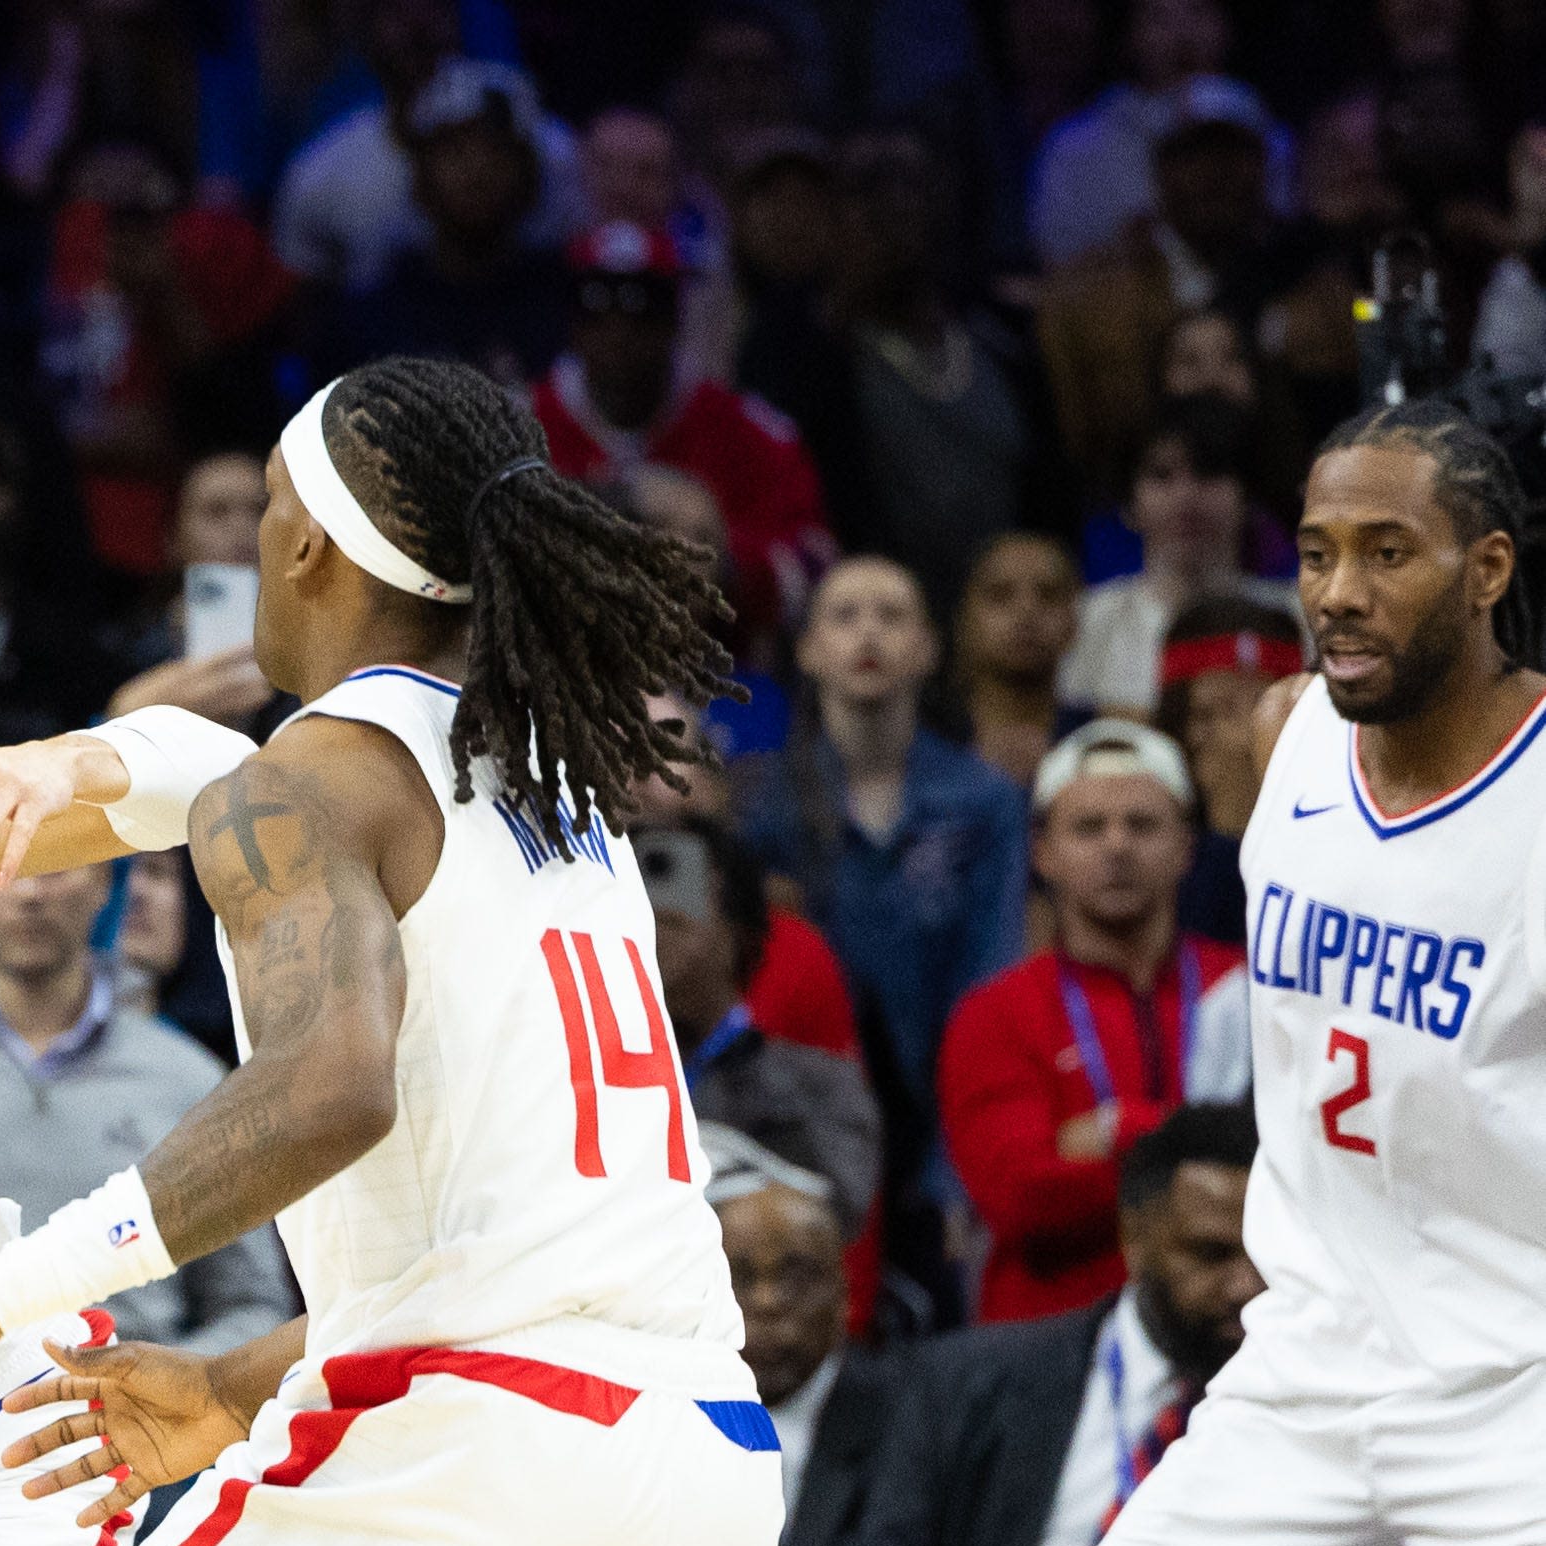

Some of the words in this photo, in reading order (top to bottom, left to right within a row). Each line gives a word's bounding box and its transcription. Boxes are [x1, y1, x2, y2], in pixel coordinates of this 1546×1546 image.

[1252, 881, 1486, 1040] CLIPPERS
[540, 927, 691, 1183] 14
[1319, 1026, 1378, 1157] 2
